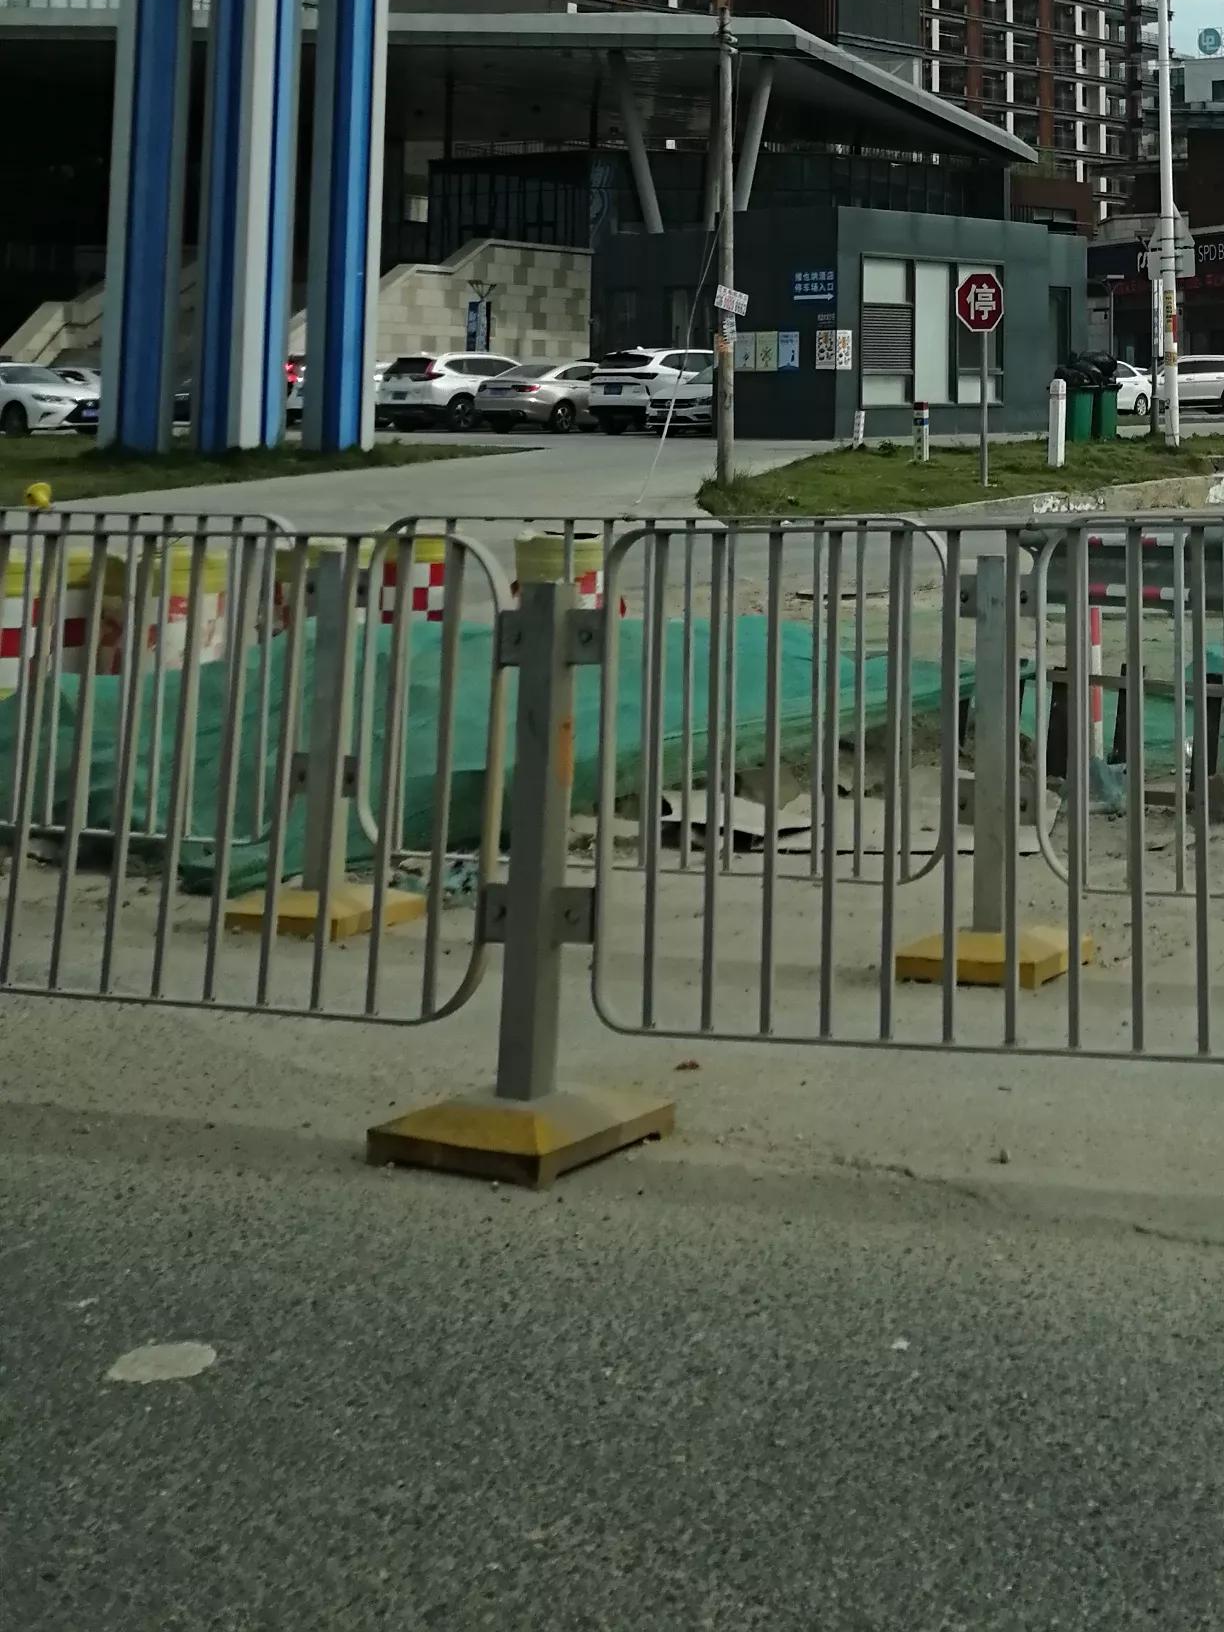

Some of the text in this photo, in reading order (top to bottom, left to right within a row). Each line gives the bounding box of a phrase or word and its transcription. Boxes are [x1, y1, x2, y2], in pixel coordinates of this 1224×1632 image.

[1198, 244, 1217, 263] SPD
[794, 282, 834, 292] 停车场入口
[966, 283, 996, 320] 停
